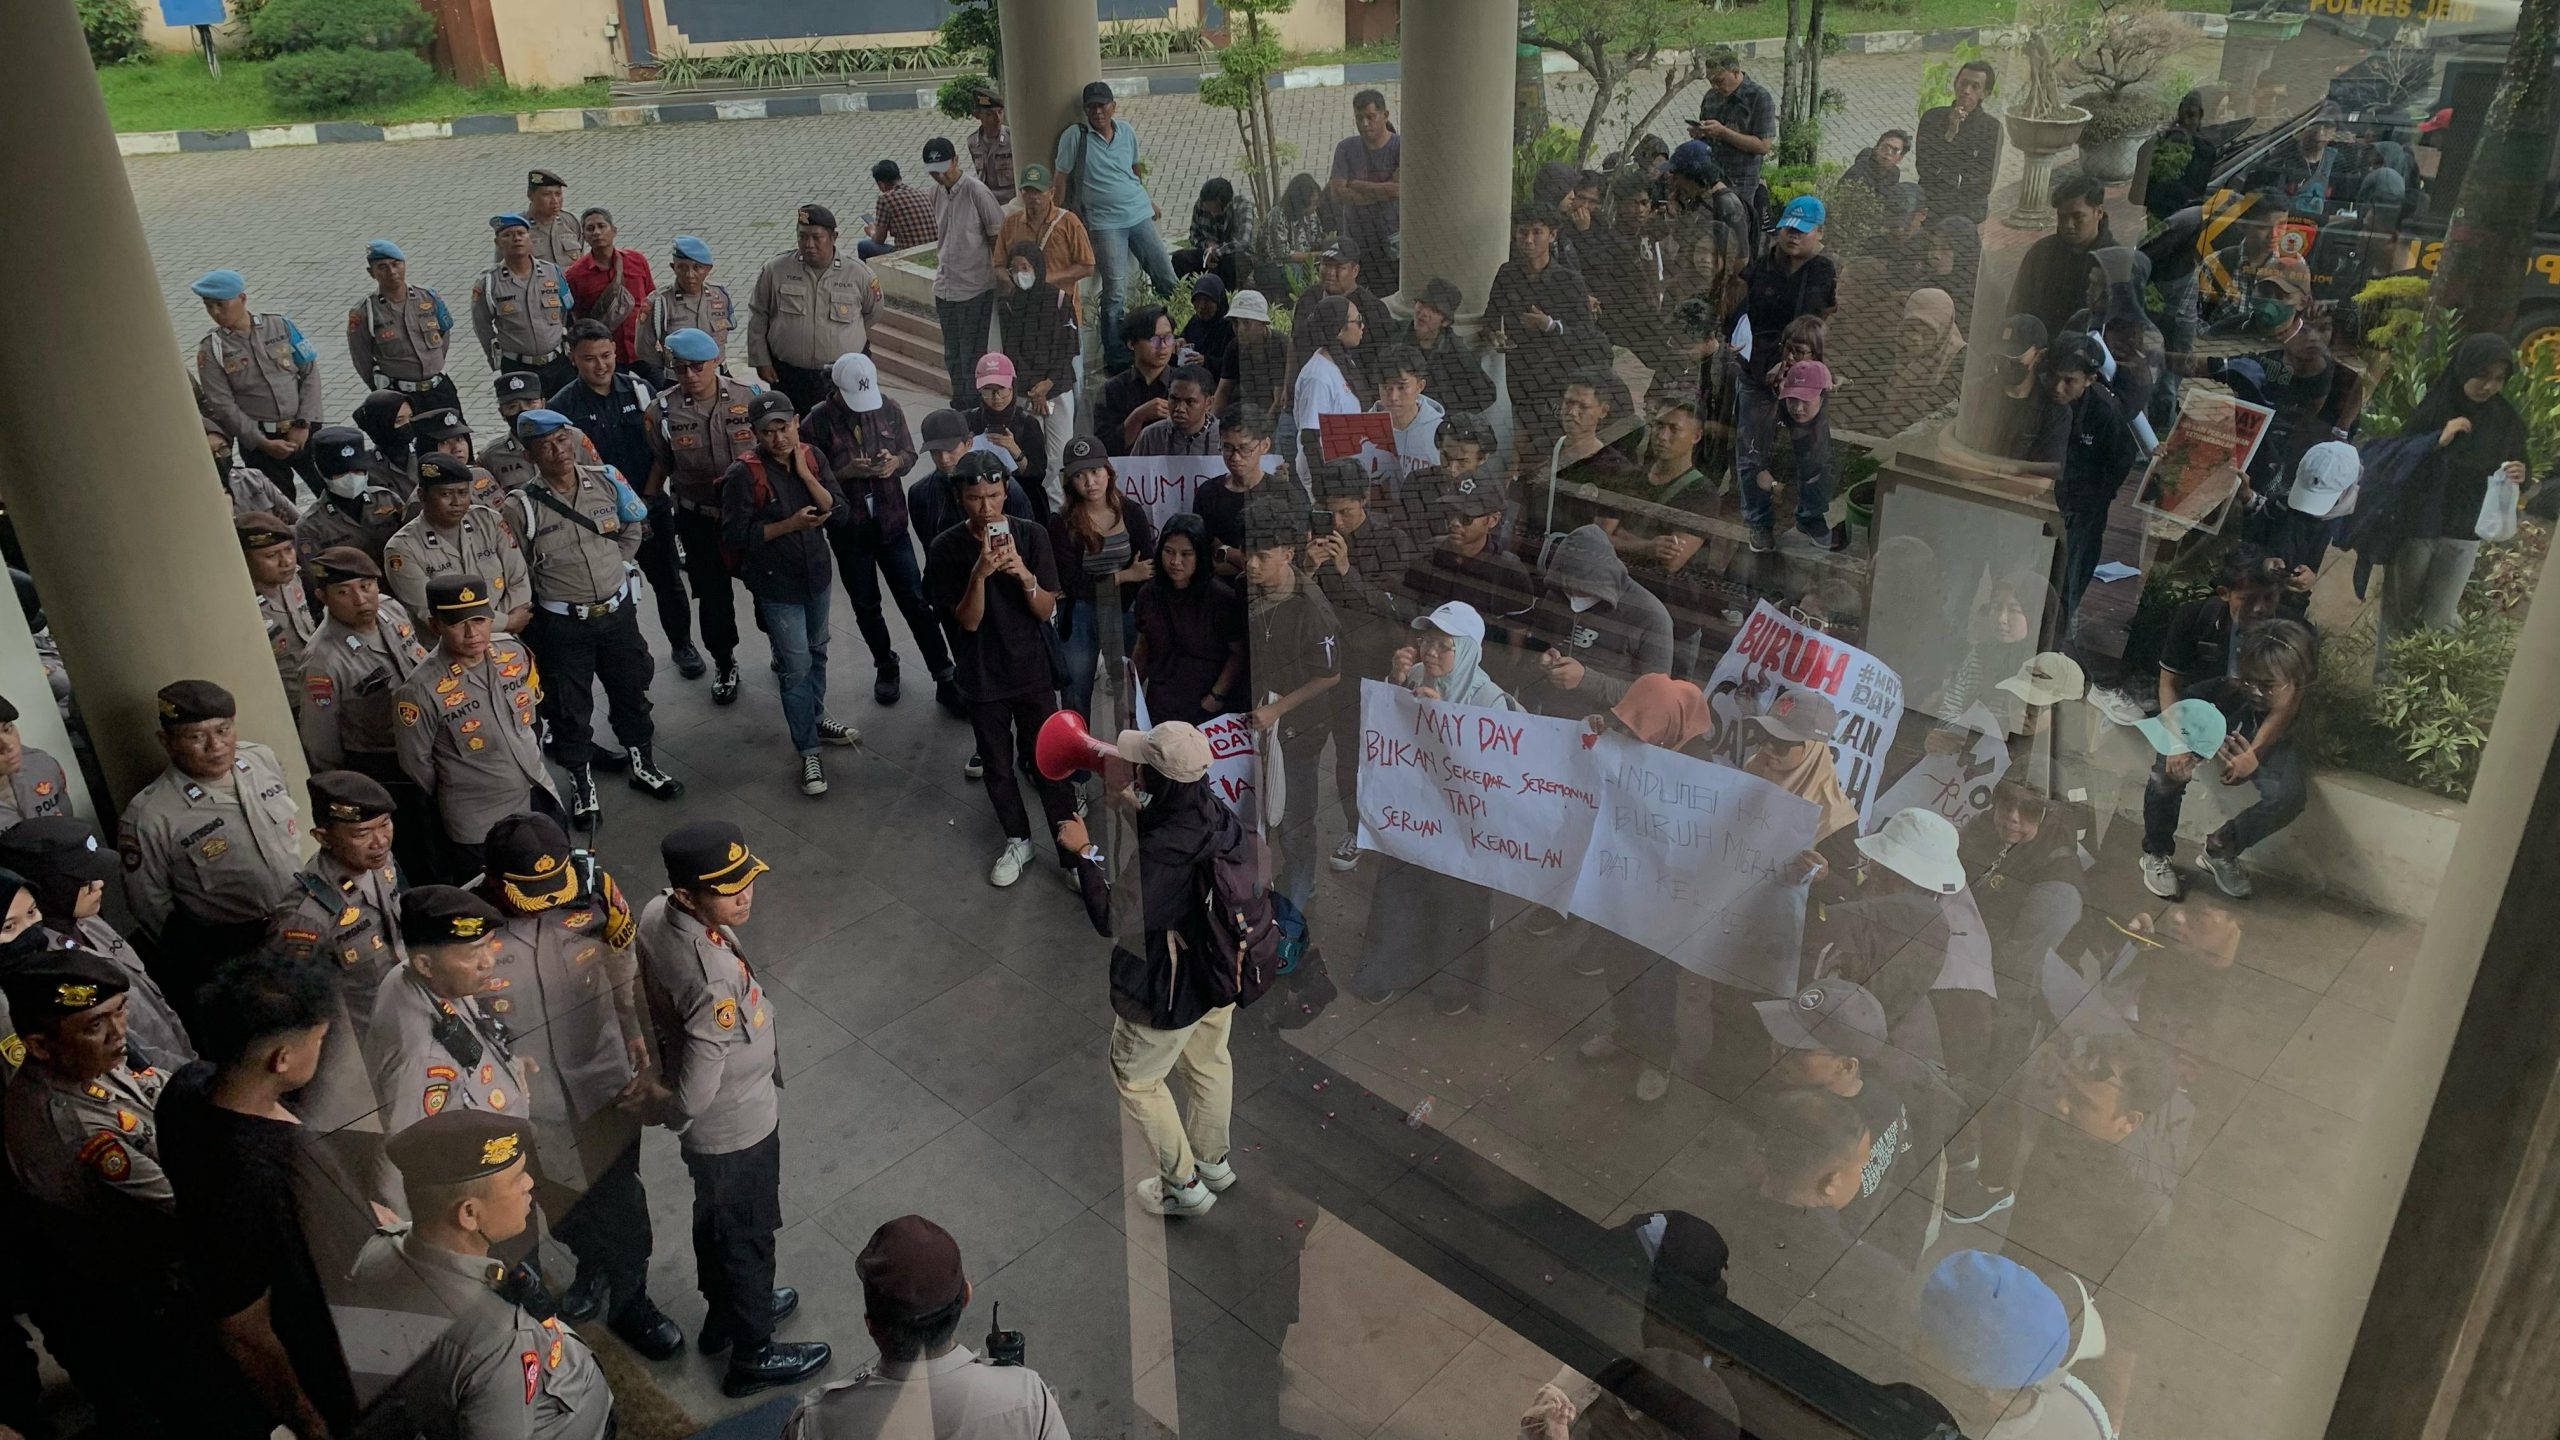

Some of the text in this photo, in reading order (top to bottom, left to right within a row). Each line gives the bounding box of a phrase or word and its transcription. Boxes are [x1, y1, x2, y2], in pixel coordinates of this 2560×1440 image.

[1737, 611, 1850, 696] BURUH
[444, 699, 481, 722] TANTO
[1851, 682, 1896, 719] DAY
[1205, 715, 1253, 738] MAY
[1213, 732, 1253, 751] DAY
[1416, 703, 1524, 756] MAY DAY
[1366, 730, 1599, 809] BUKAN SEKEDAR SEREMONIAL
[1443, 788, 1487, 819] TAPI
[1378, 806, 1562, 869] SERUAN KEADILAN
[1615, 806, 1713, 850] BURUH
